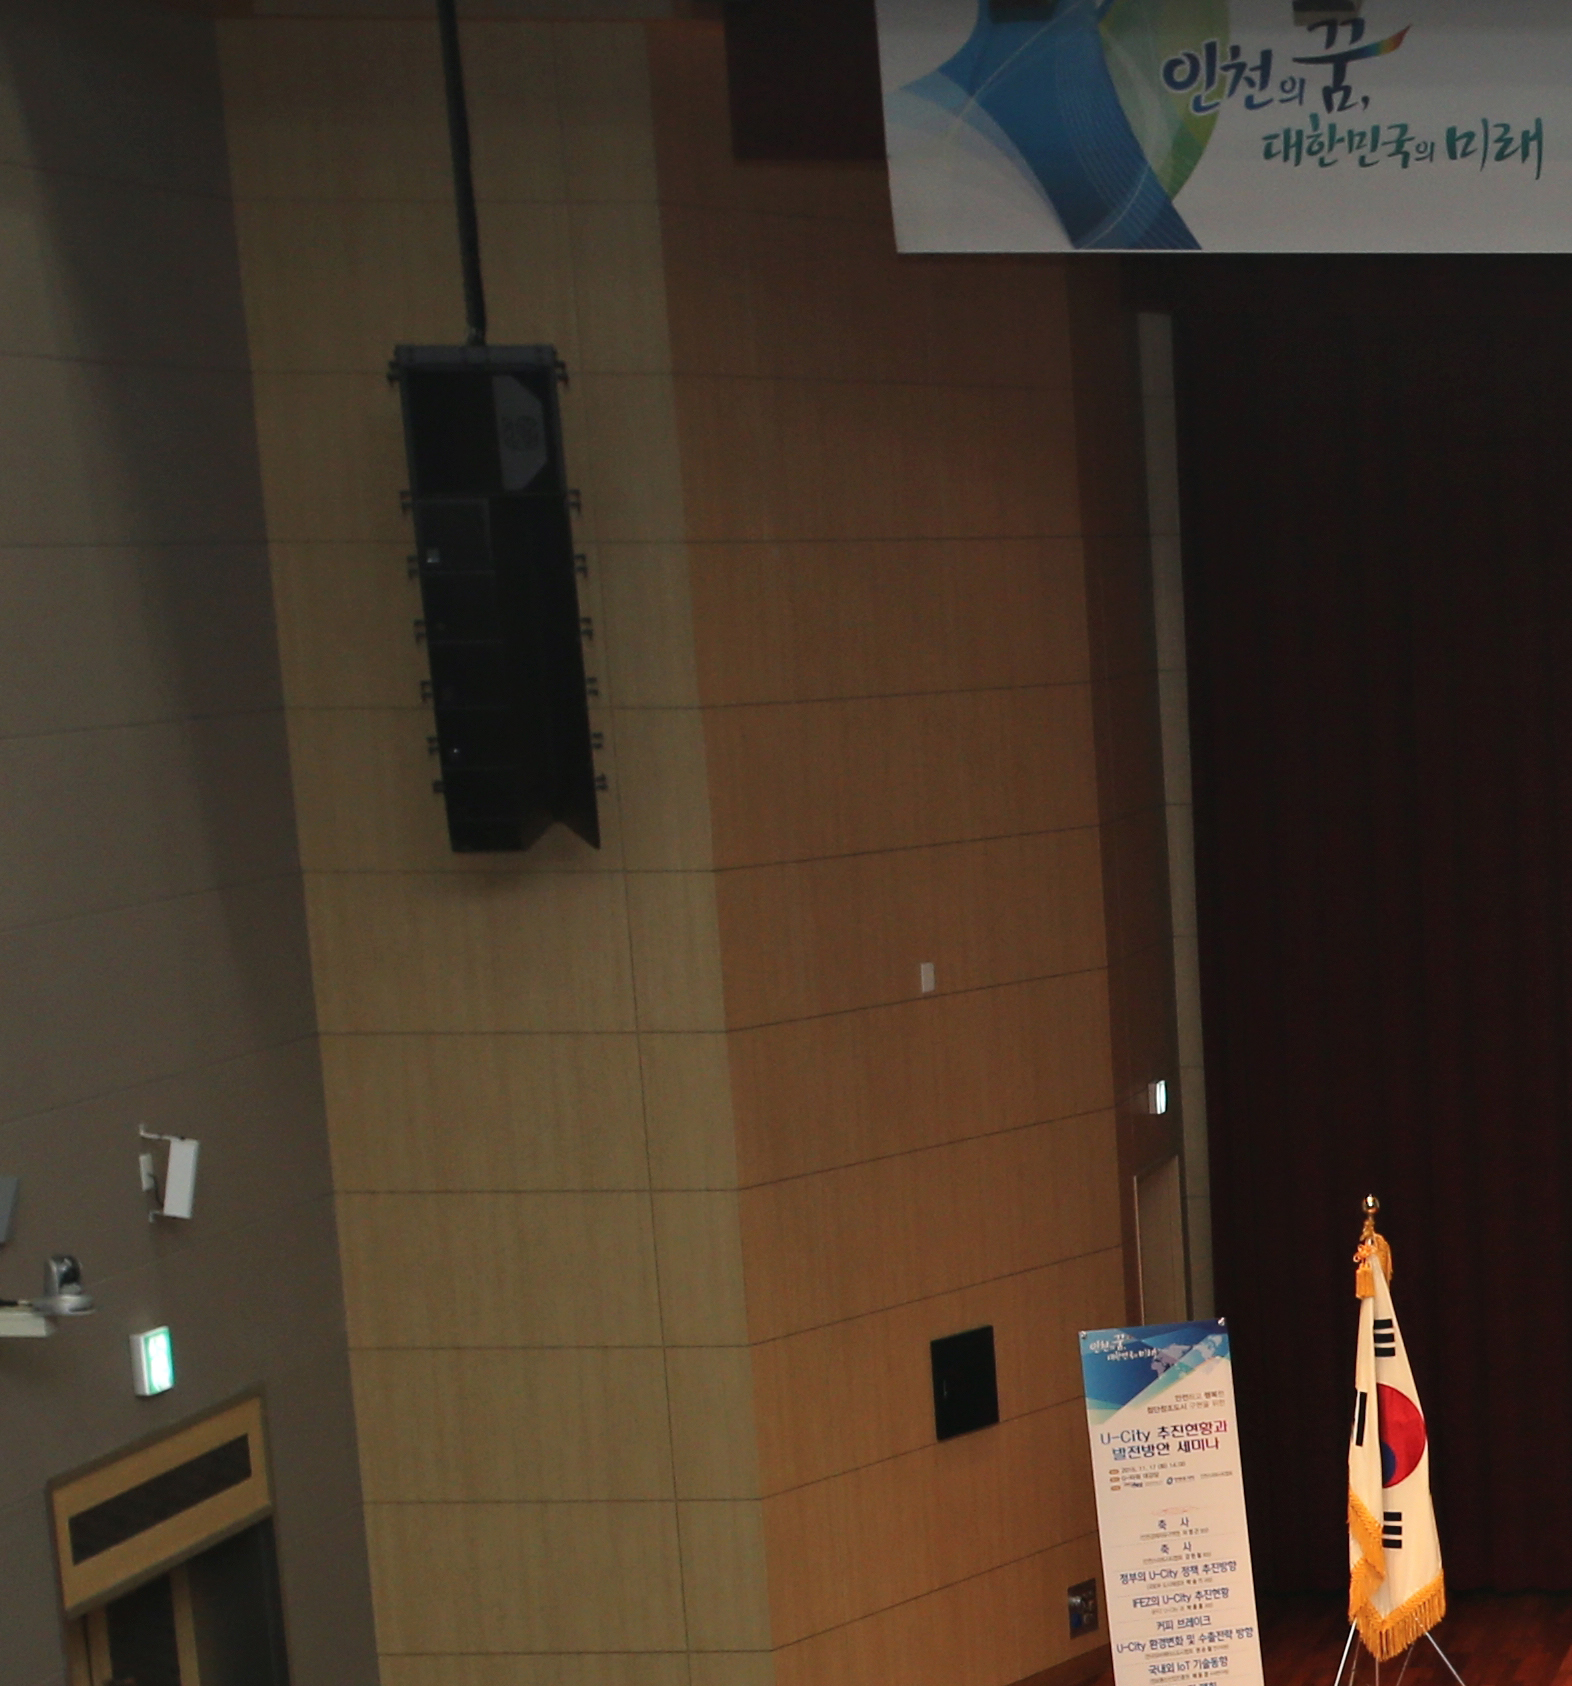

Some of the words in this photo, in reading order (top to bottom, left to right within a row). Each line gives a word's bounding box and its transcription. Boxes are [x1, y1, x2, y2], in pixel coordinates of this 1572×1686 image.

[1162, 41, 1306, 113] 인천의
[1291, 17, 1411, 114] 꿈,
[1262, 113, 1435, 169] 대한민국의
[1446, 117, 1543, 180] 미래
[1100, 1430, 1151, 1445] U-City
[1157, 1420, 1228, 1439] 추진현황과
[1112, 1443, 1170, 1461] 발전방안
[1177, 1437, 1220, 1453] 세미나
[1149, 1568, 1178, 1580] U-City
[1162, 1593, 1192, 1605] U-City
[1156, 1619, 1174, 1631] 커피
[1177, 1615, 1212, 1629] 브레이크
[1116, 1642, 1146, 1654] U-City
